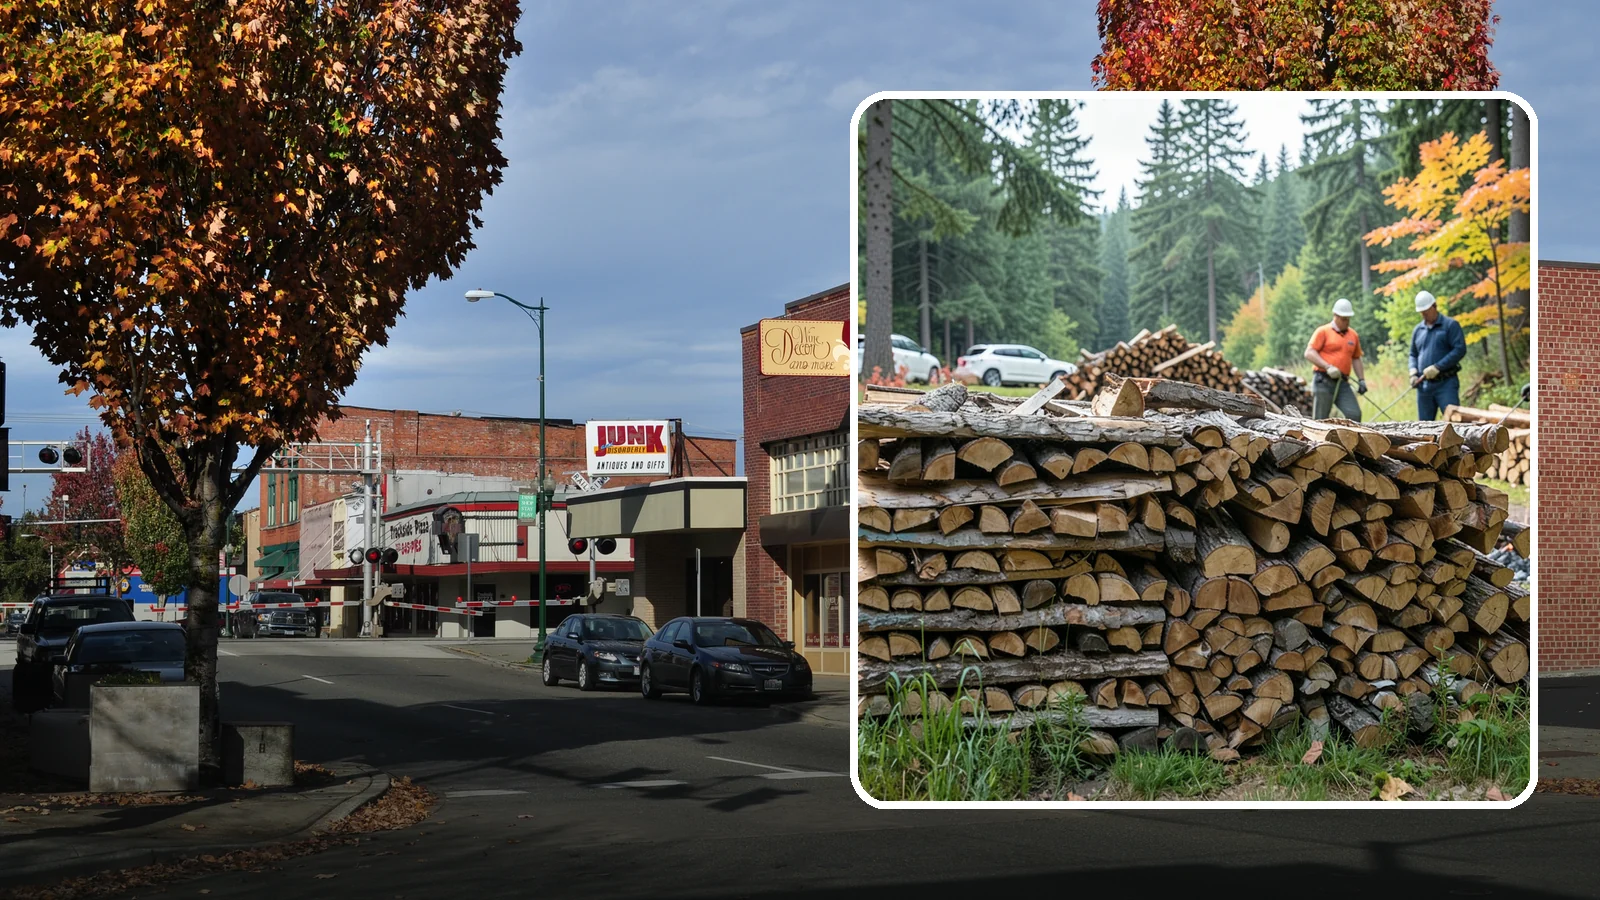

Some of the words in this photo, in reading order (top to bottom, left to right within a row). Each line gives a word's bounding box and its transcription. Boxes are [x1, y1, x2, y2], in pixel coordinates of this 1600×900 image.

[765, 328, 831, 365] Decor
[595, 425, 665, 457] JUNK
[607, 446, 646, 454] DISORDERLY
[596, 461, 628, 470] ANTIQUES
[631, 460, 644, 470] AND
[647, 460, 665, 469] GIFTS
[414, 519, 429, 535] Pizza
